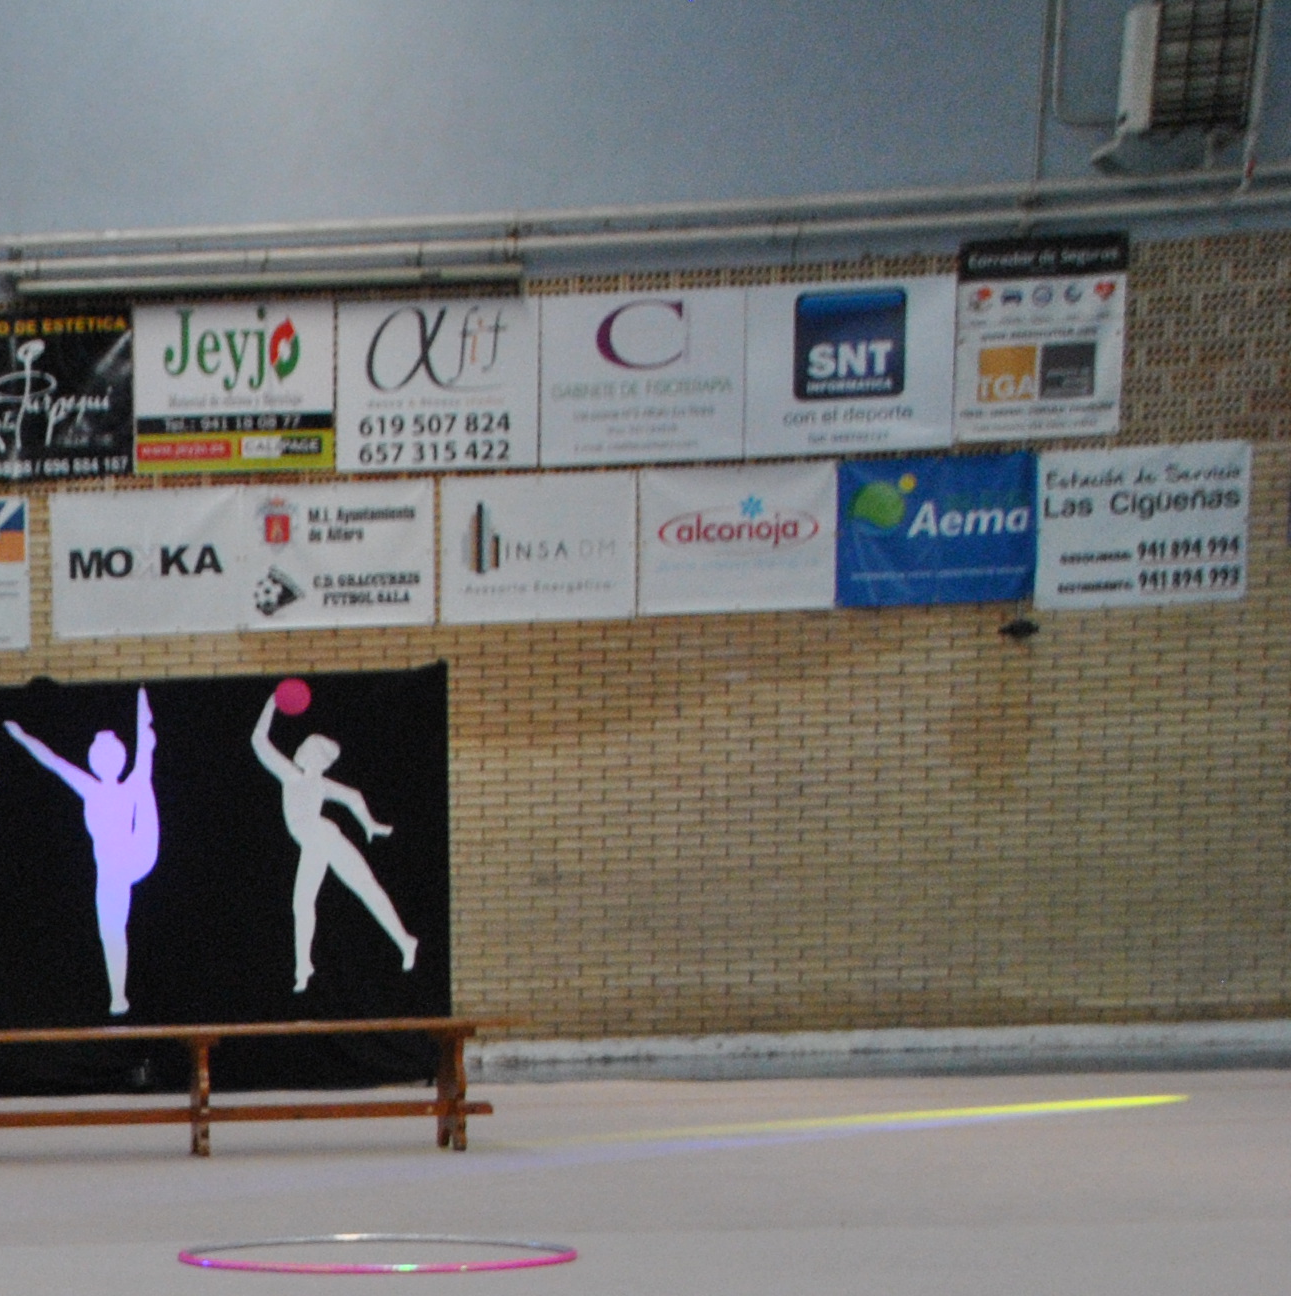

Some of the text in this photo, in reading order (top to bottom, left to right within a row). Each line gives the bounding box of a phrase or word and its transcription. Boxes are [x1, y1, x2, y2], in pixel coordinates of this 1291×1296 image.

[14, 319, 37, 336] DE
[164, 305, 300, 390] Jeyjo
[807, 339, 894, 379] SNT
[358, 411, 510, 437] 619 507 824
[358, 438, 510, 464] 657 315 422
[1044, 495, 1093, 520] Las
[1137, 540, 1166, 560] 941
[1138, 569, 1167, 590] 941
